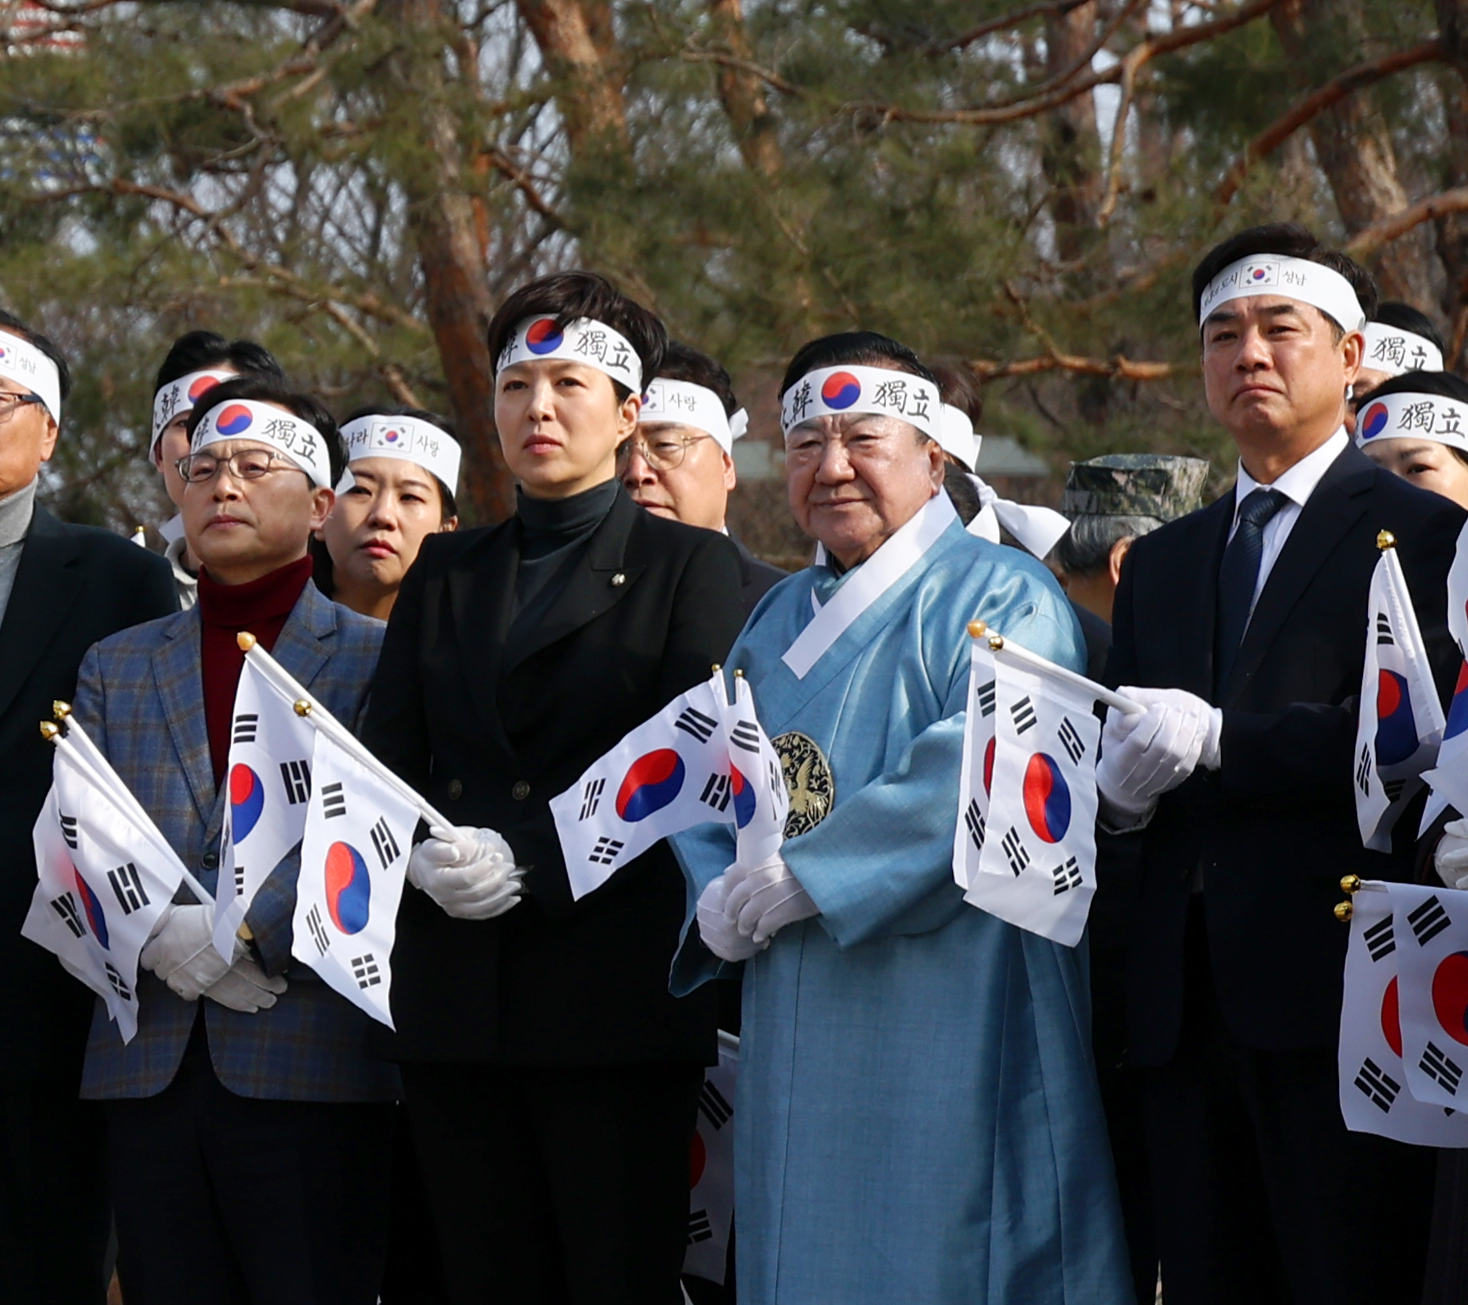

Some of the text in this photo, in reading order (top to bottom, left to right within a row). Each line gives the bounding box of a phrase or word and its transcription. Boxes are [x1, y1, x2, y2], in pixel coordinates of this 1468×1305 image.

[1283, 270, 1307, 287] 성남
[18, 356, 37, 375] 성남
[574, 330, 631, 373] 獨立
[1370, 336, 1428, 371] 獨立
[668, 393, 698, 413] 사랑
[871, 380, 931, 423] 獨立
[1396, 401, 1466, 439] 獨立
[261, 418, 317, 469] 獨立
[345, 427, 440, 458] 나라 사랑
